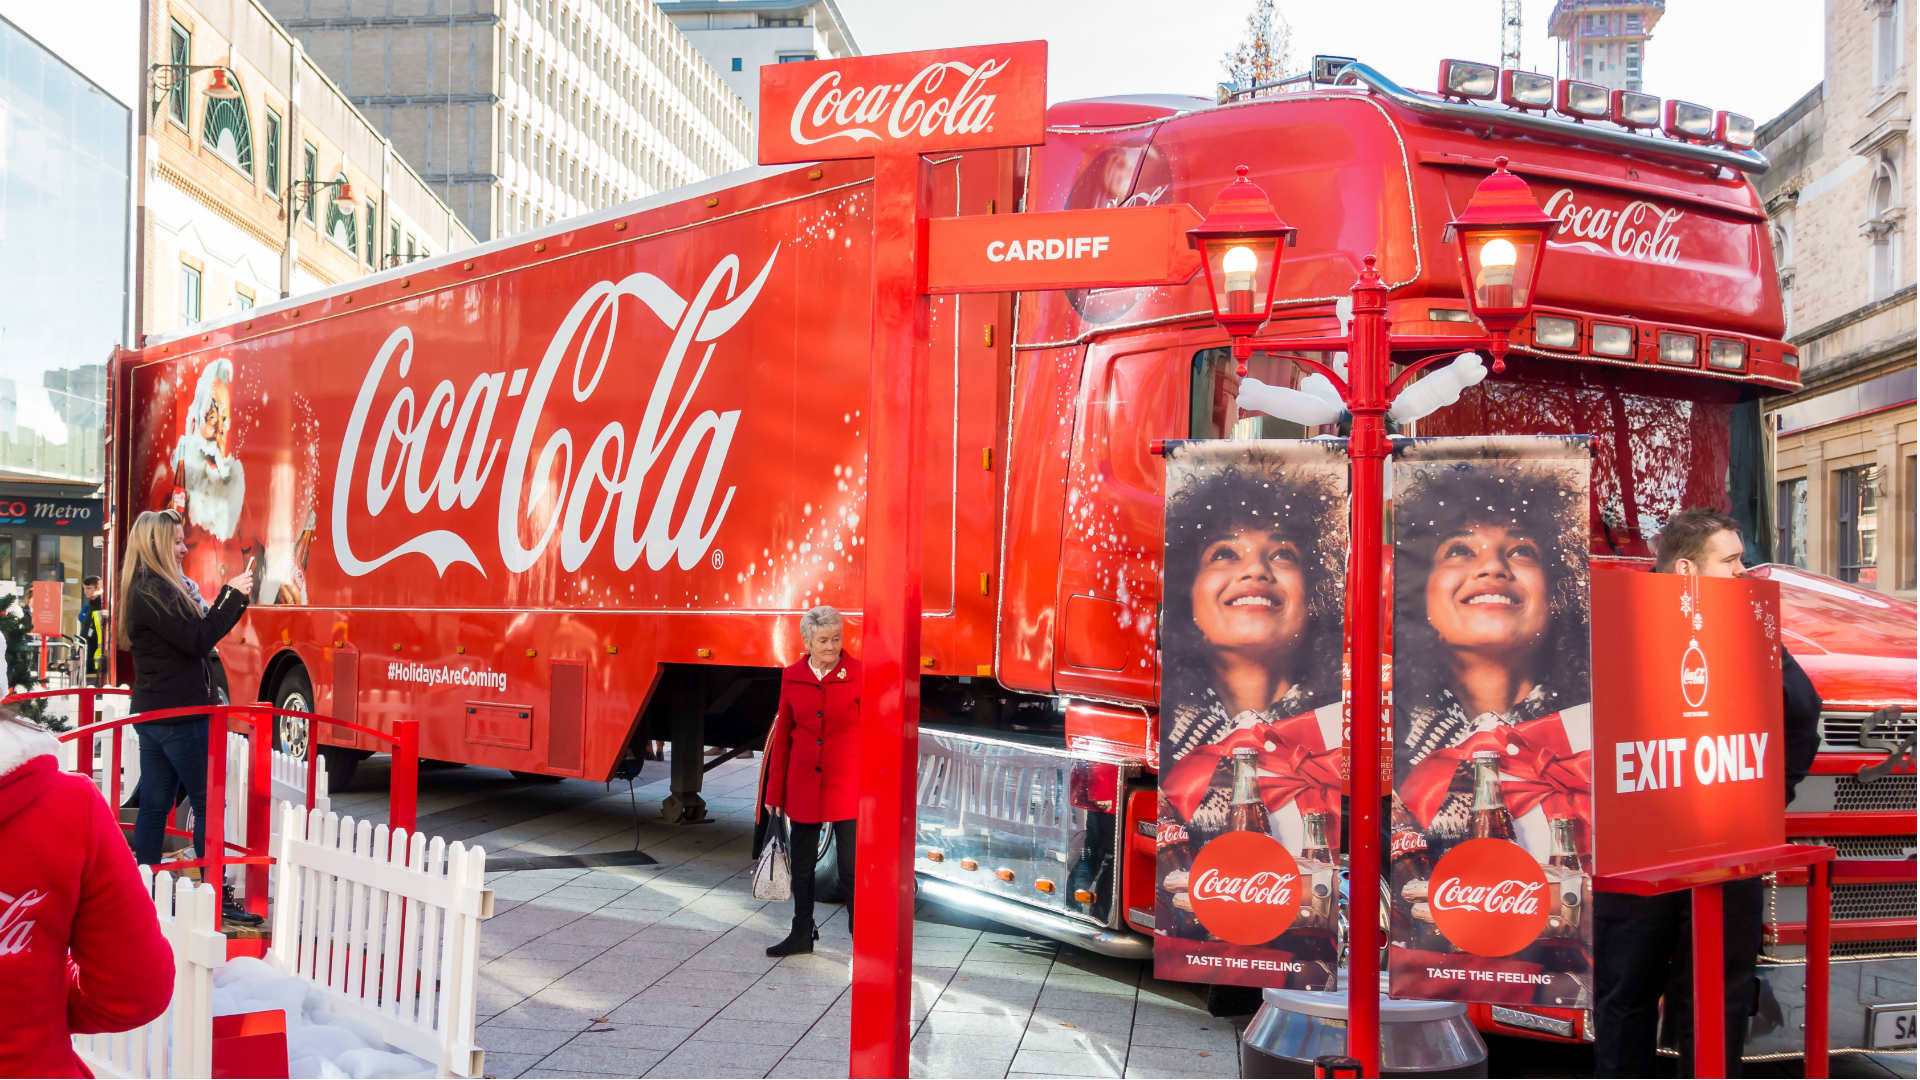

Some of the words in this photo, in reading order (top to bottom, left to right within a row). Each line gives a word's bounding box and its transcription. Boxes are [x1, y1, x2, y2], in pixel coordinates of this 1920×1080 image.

[790, 58, 1011, 145] Coca-Cola
[1543, 188, 1686, 265] Coca-Cola
[986, 236, 1110, 262] CARDIFF
[331, 241, 781, 579] Coca-Cola
[33, 503, 91, 519] Metro
[388, 662, 507, 692] #HolidaysAreComing
[1616, 738, 1687, 794] EXIT
[1694, 732, 1769, 786] ONLY
[1193, 868, 1297, 906] Coca-Cola
[1433, 877, 1545, 915] Coca-Cola
[1185, 954, 1222, 967] TASTE
[1225, 957, 1248, 969] THE
[1251, 960, 1303, 973] FEELING
[1426, 967, 1466, 980] TASTE
[1469, 970, 1494, 982] THE
[1496, 972, 1551, 985] FEELING
